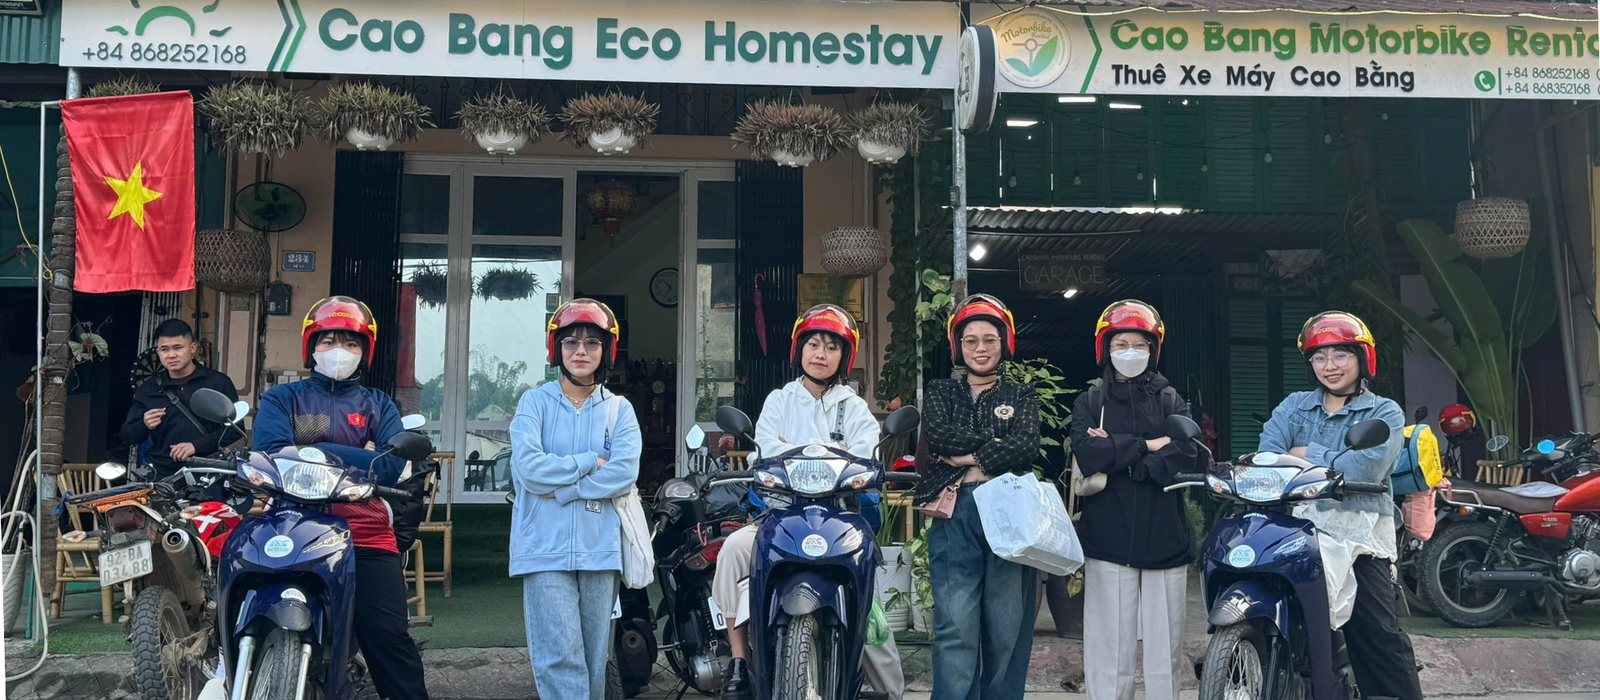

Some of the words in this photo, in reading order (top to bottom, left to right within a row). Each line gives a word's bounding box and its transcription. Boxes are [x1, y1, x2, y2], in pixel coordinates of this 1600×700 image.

[319, 8, 425, 54] Cao
[449, 13, 573, 70] Bang
[596, 18, 682, 60] Eco
[704, 21, 943, 75] Homestay
[1001, 21, 1052, 42] Motorbike
[1110, 19, 1189, 51] Cao
[1203, 21, 1296, 61] Bang
[1309, 22, 1491, 56] Motorbike
[82, 42, 123, 62] +84
[130, 43, 247, 64] 868252168
[1111, 63, 1167, 86] Thuê
[1179, 65, 1212, 86] Xe
[1226, 63, 1276, 91] Máy
[1290, 66, 1341, 87] Cao
[1355, 60, 1415, 92] Bằng
[1505, 67, 1528, 78] +84
[1532, 67, 1591, 80] 868252168
[1505, 82, 1529, 94] +84
[1532, 82, 1591, 95] 868352168
[288, 253, 310, 263] 234
[1023, 265, 1105, 284] GARAGE
[275, 510, 304, 518] HONDA
[107, 546, 143, 567] 92-BA
